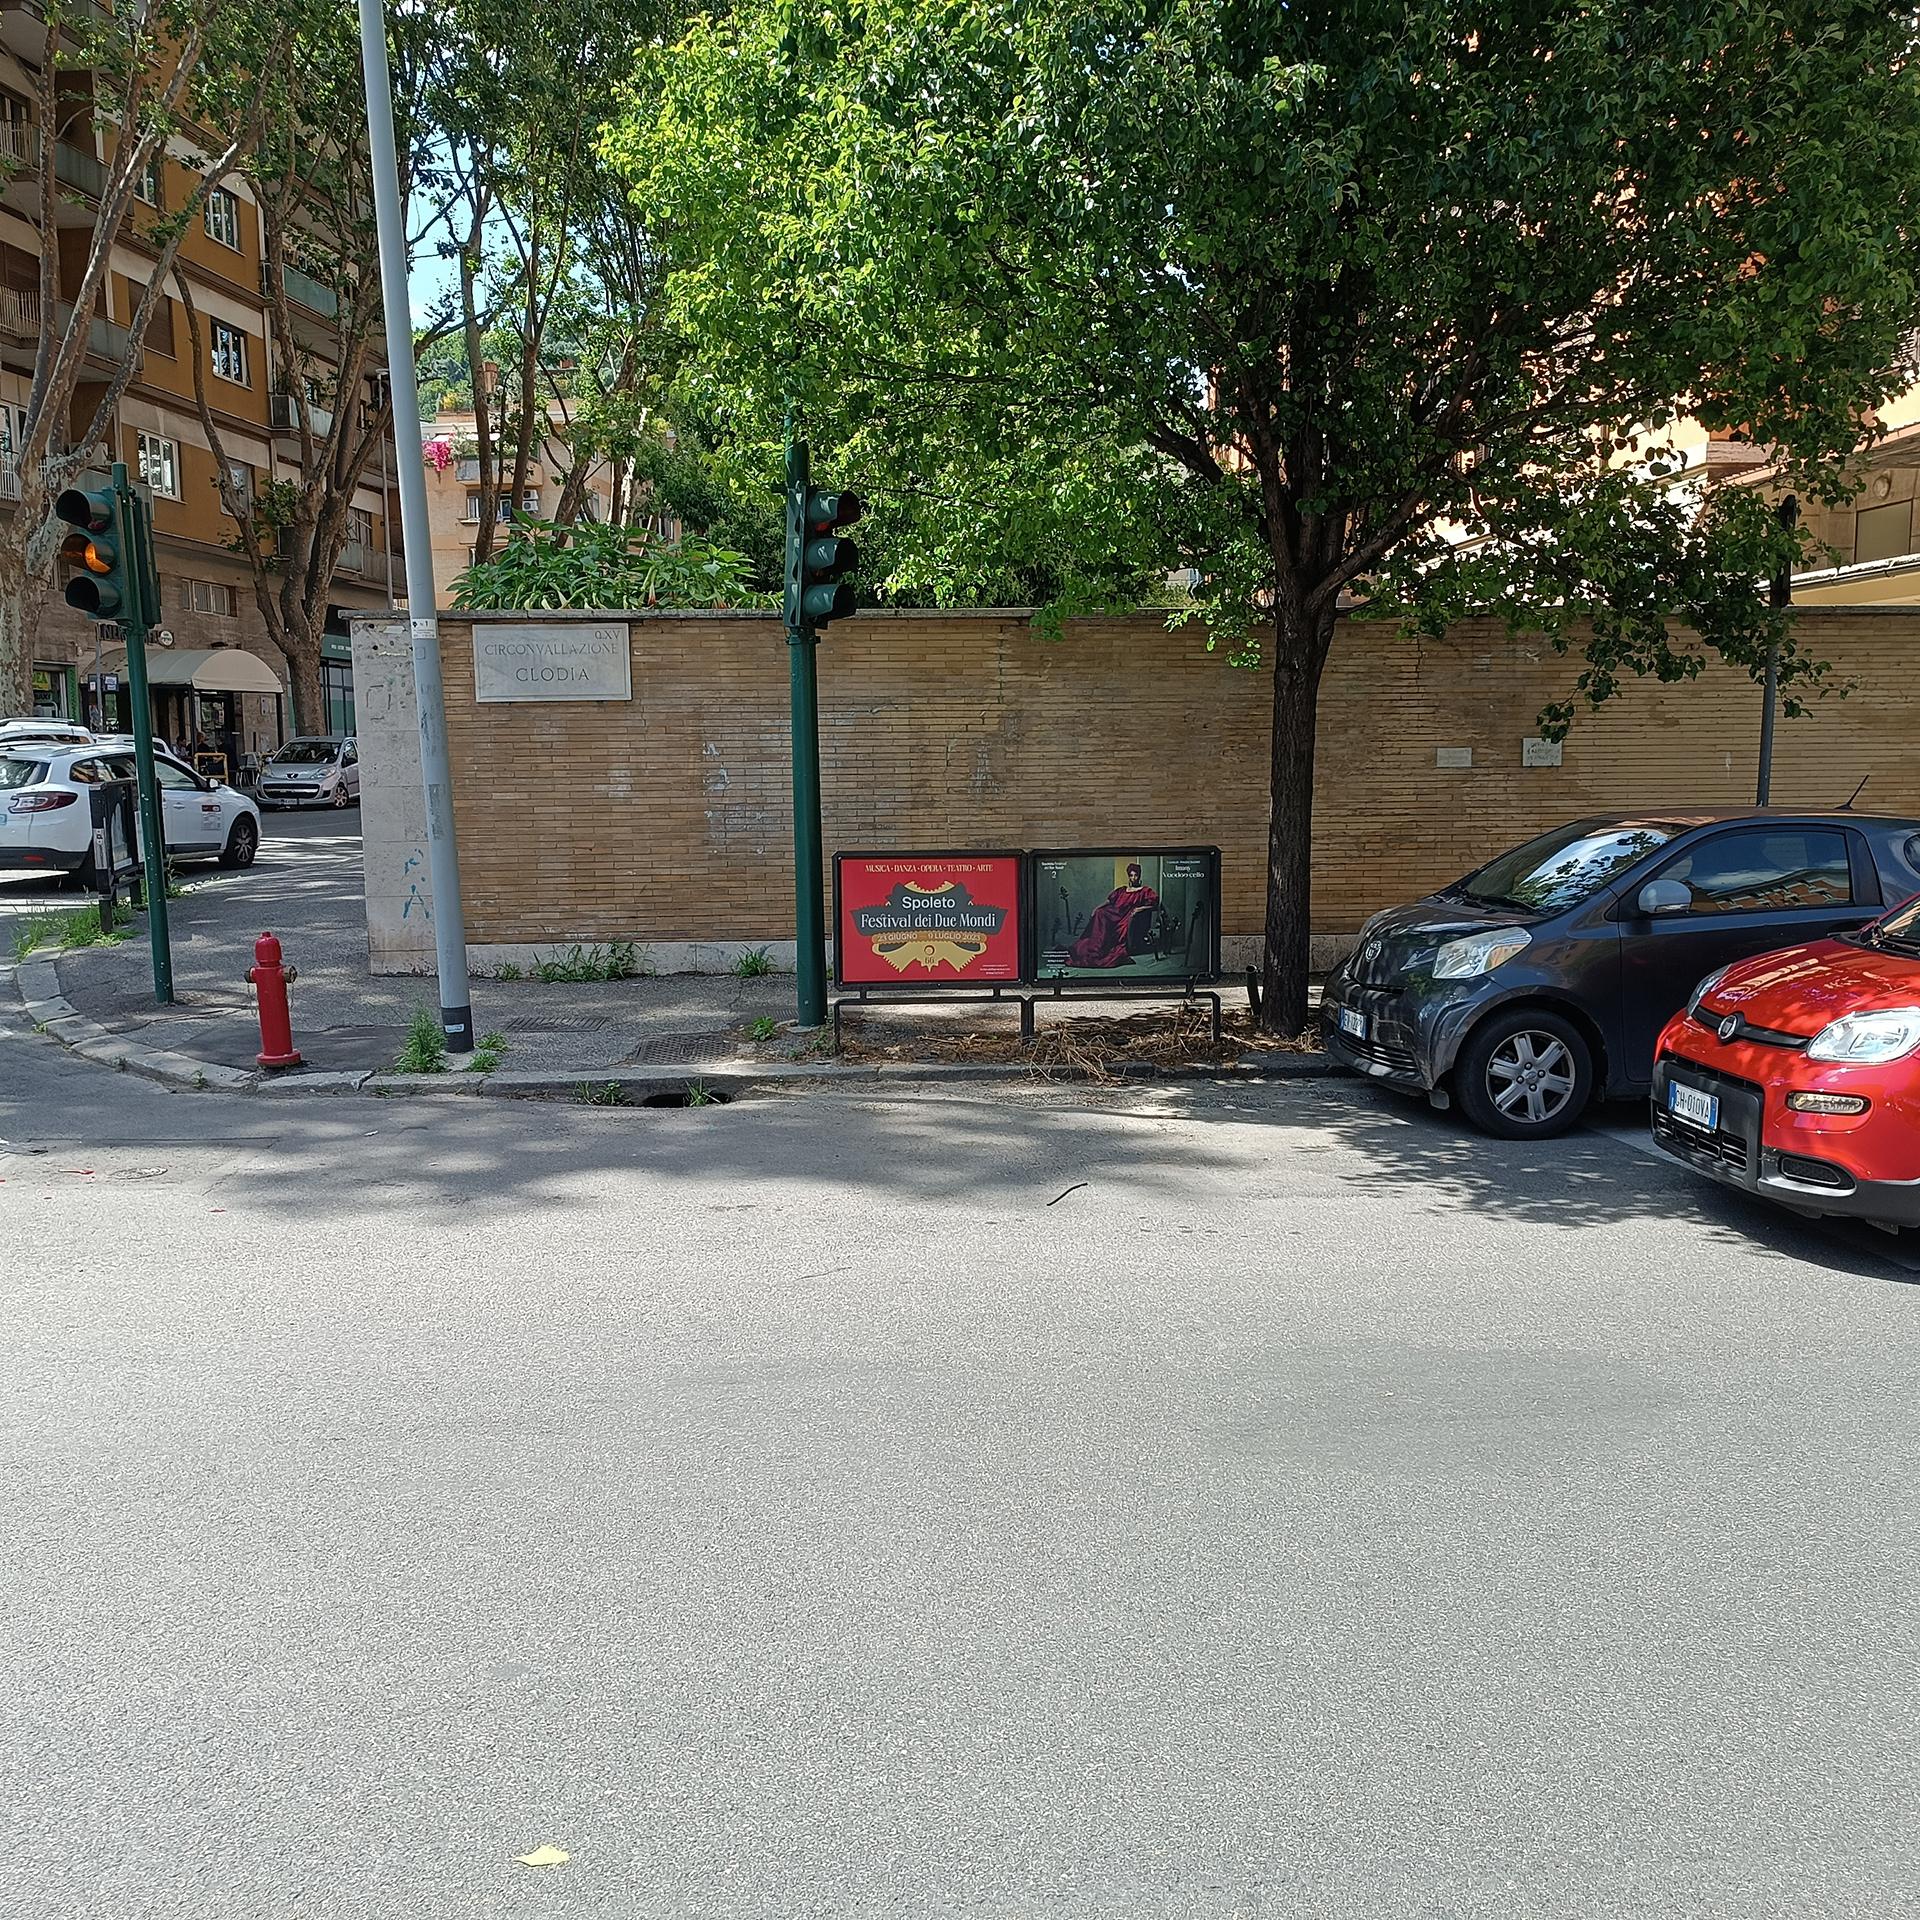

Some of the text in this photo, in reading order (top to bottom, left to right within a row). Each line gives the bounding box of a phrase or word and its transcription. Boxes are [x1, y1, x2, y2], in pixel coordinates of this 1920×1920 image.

[484, 642, 618, 656] CIRCONVALLAZIONE
[515, 667, 590, 682] CLODIA
[864, 864, 994, 873] MUSICA DANZA OPERA TEATRO ARTE
[901, 896, 956, 911] Spoleto
[861, 913, 996, 929] Festival dei Due Mondi
[888, 933, 918, 941] GIUGNO
[934, 932, 961, 941] LUGLIO
